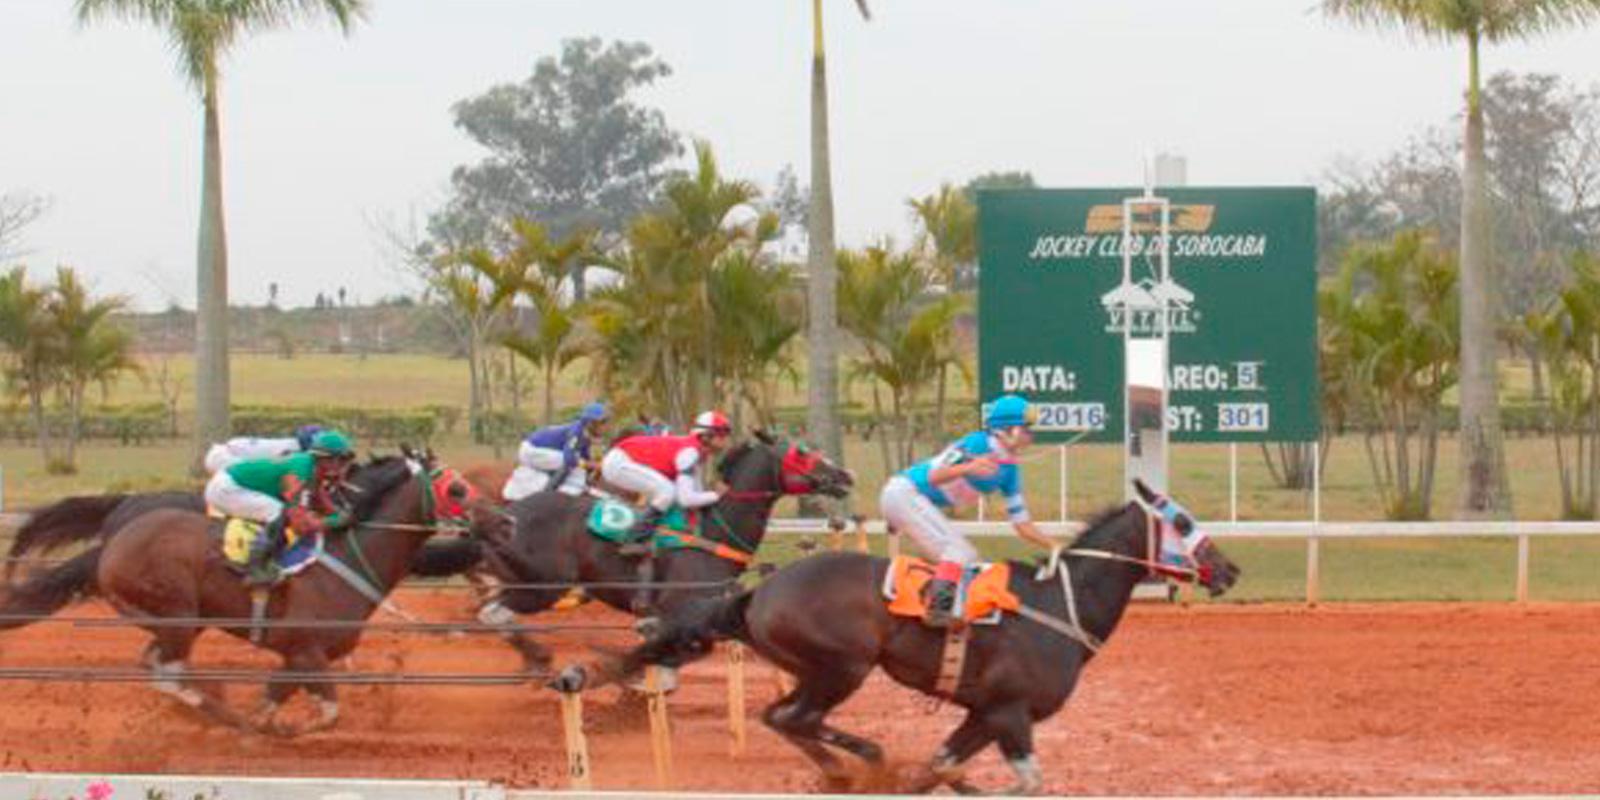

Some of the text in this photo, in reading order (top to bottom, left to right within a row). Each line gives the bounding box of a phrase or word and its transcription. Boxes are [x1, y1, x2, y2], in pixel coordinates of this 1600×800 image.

[1029, 235, 1097, 258] JOCKEY
[1174, 234, 1267, 257] SOROCABA
[1109, 311, 1191, 325] VTIL
[1002, 365, 1077, 391] DATA:
[1240, 366, 1254, 385] 5
[1039, 406, 1103, 426] 2016
[1220, 408, 1265, 427] 301
